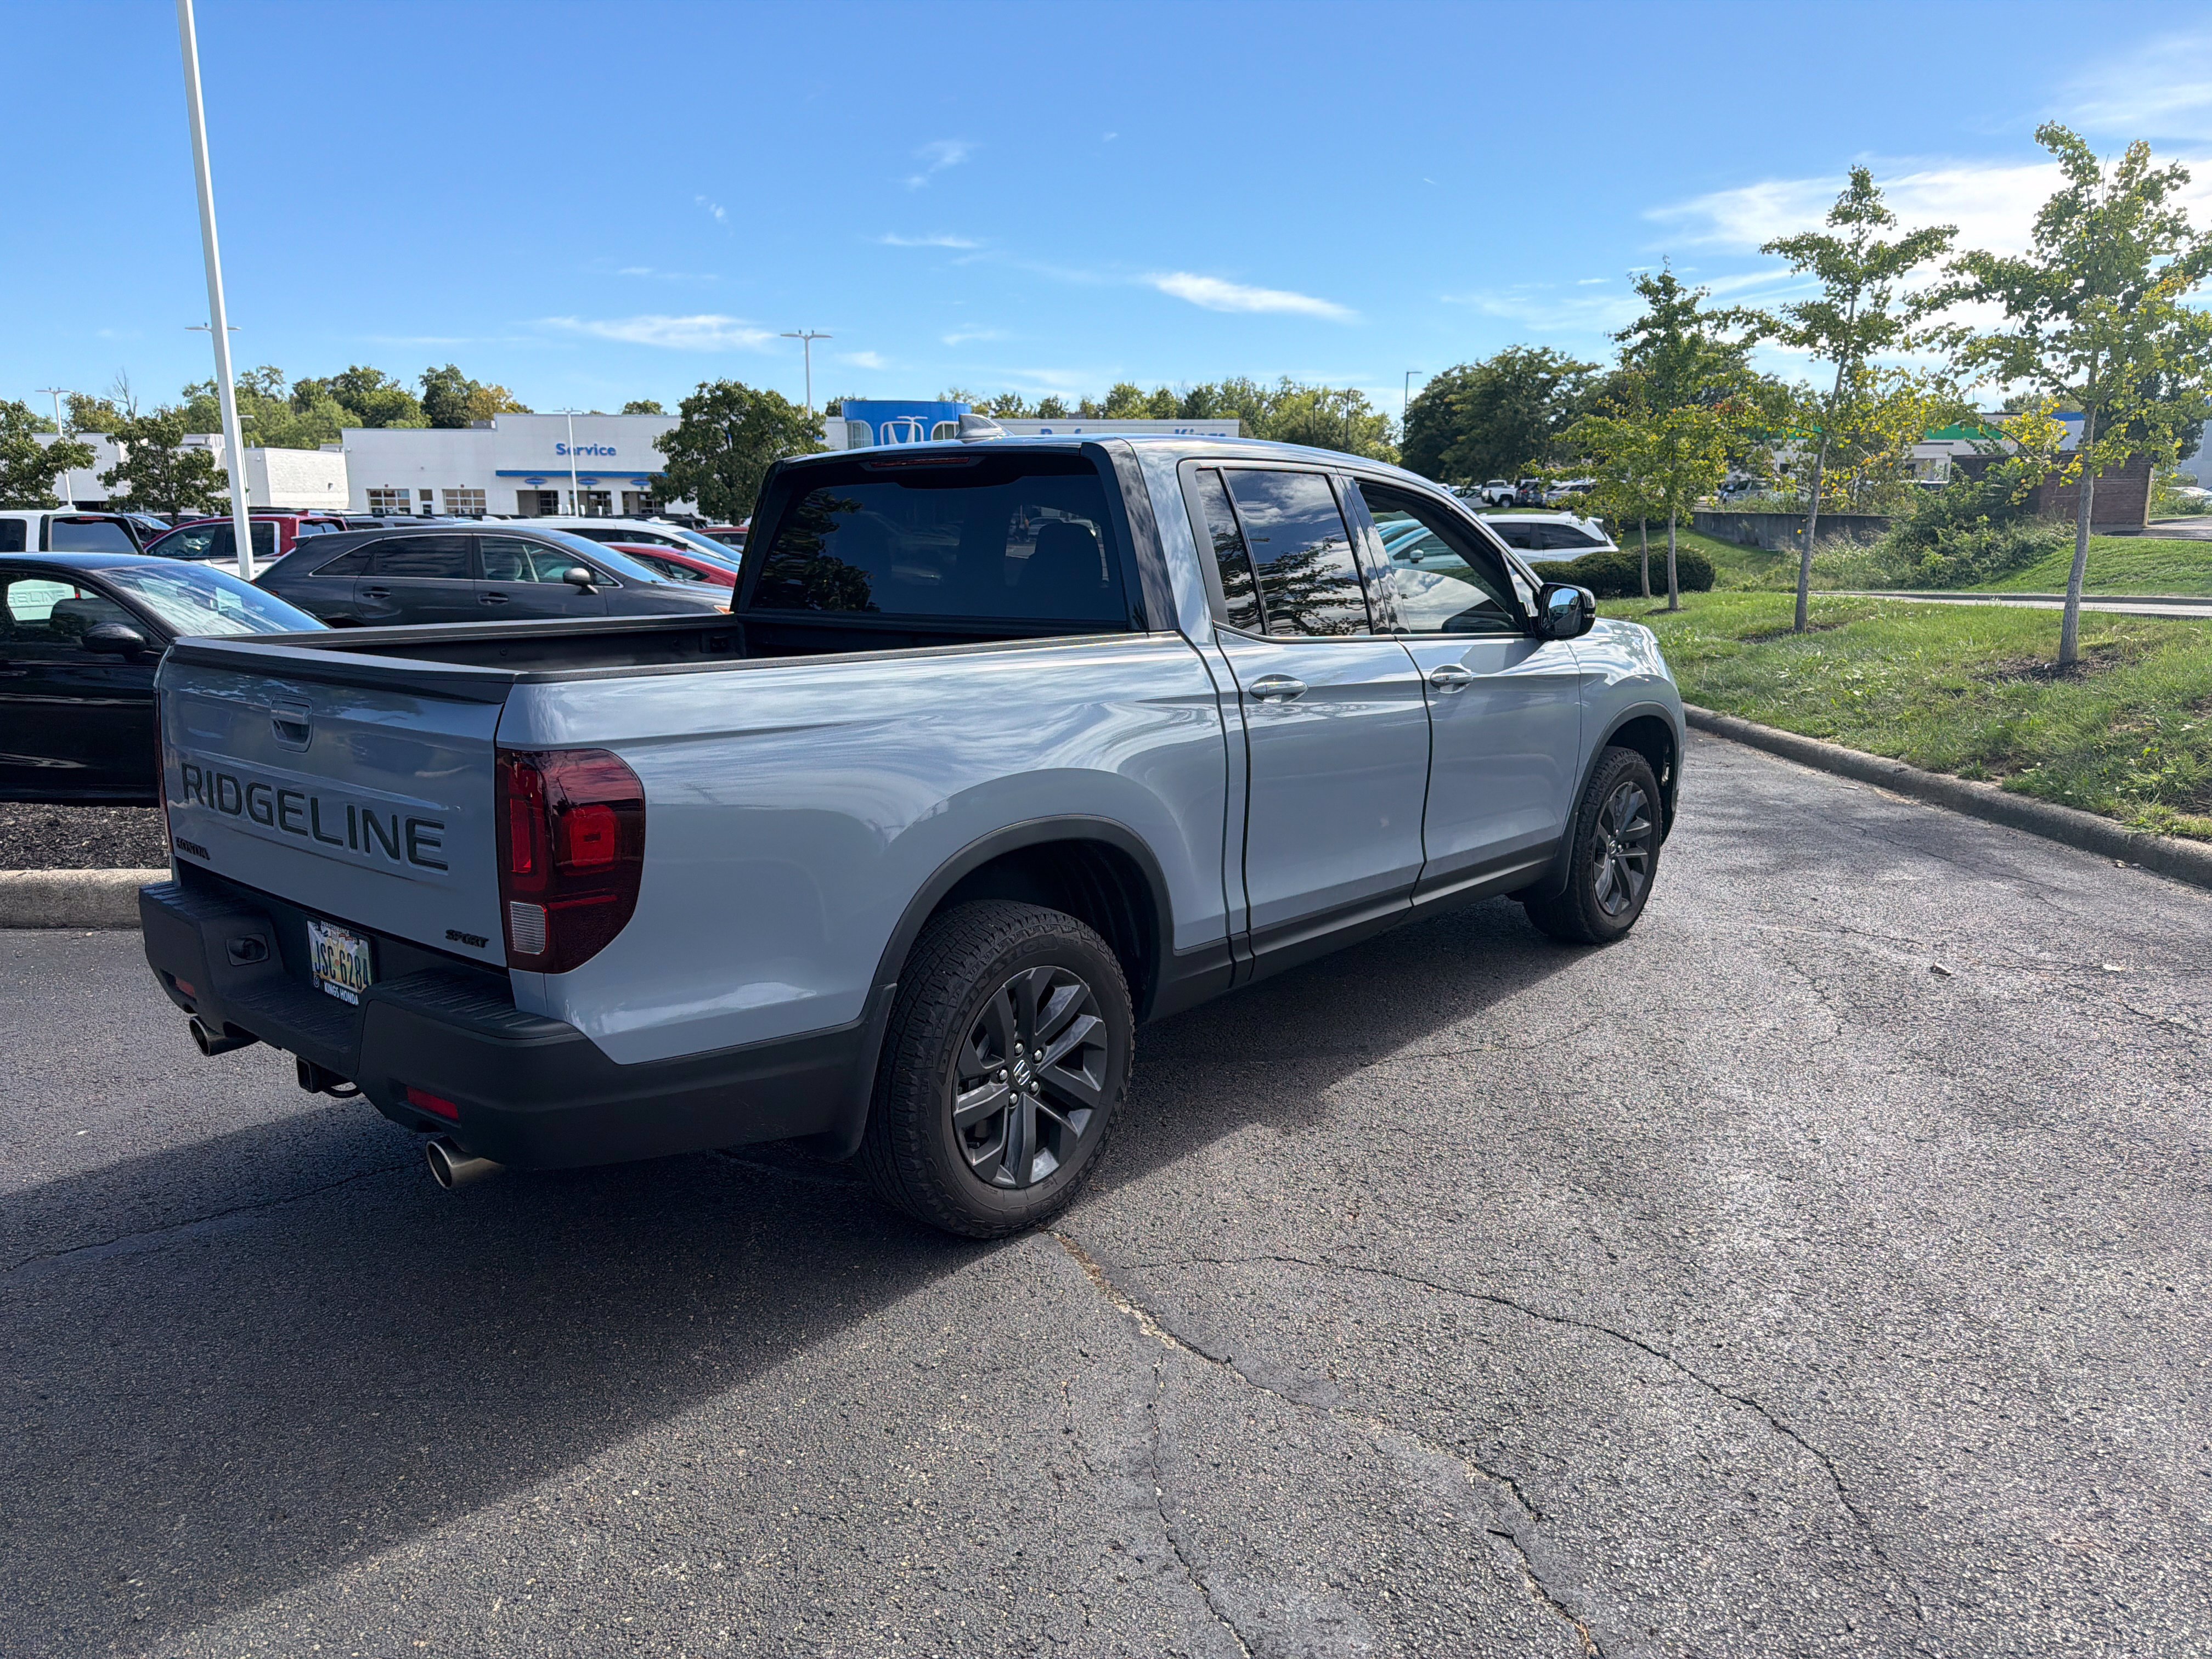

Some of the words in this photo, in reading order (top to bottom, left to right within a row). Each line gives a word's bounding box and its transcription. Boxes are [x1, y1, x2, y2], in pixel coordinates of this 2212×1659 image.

[555, 442, 617, 456] Service
[180, 761, 449, 872] RIDGELINE
[175, 836, 211, 861] HONDA
[445, 929, 489, 948] SPORT
[314, 939, 336, 979] JSC
[324, 980, 340, 998] KINGS
[340, 988, 359, 1006] HONDA
